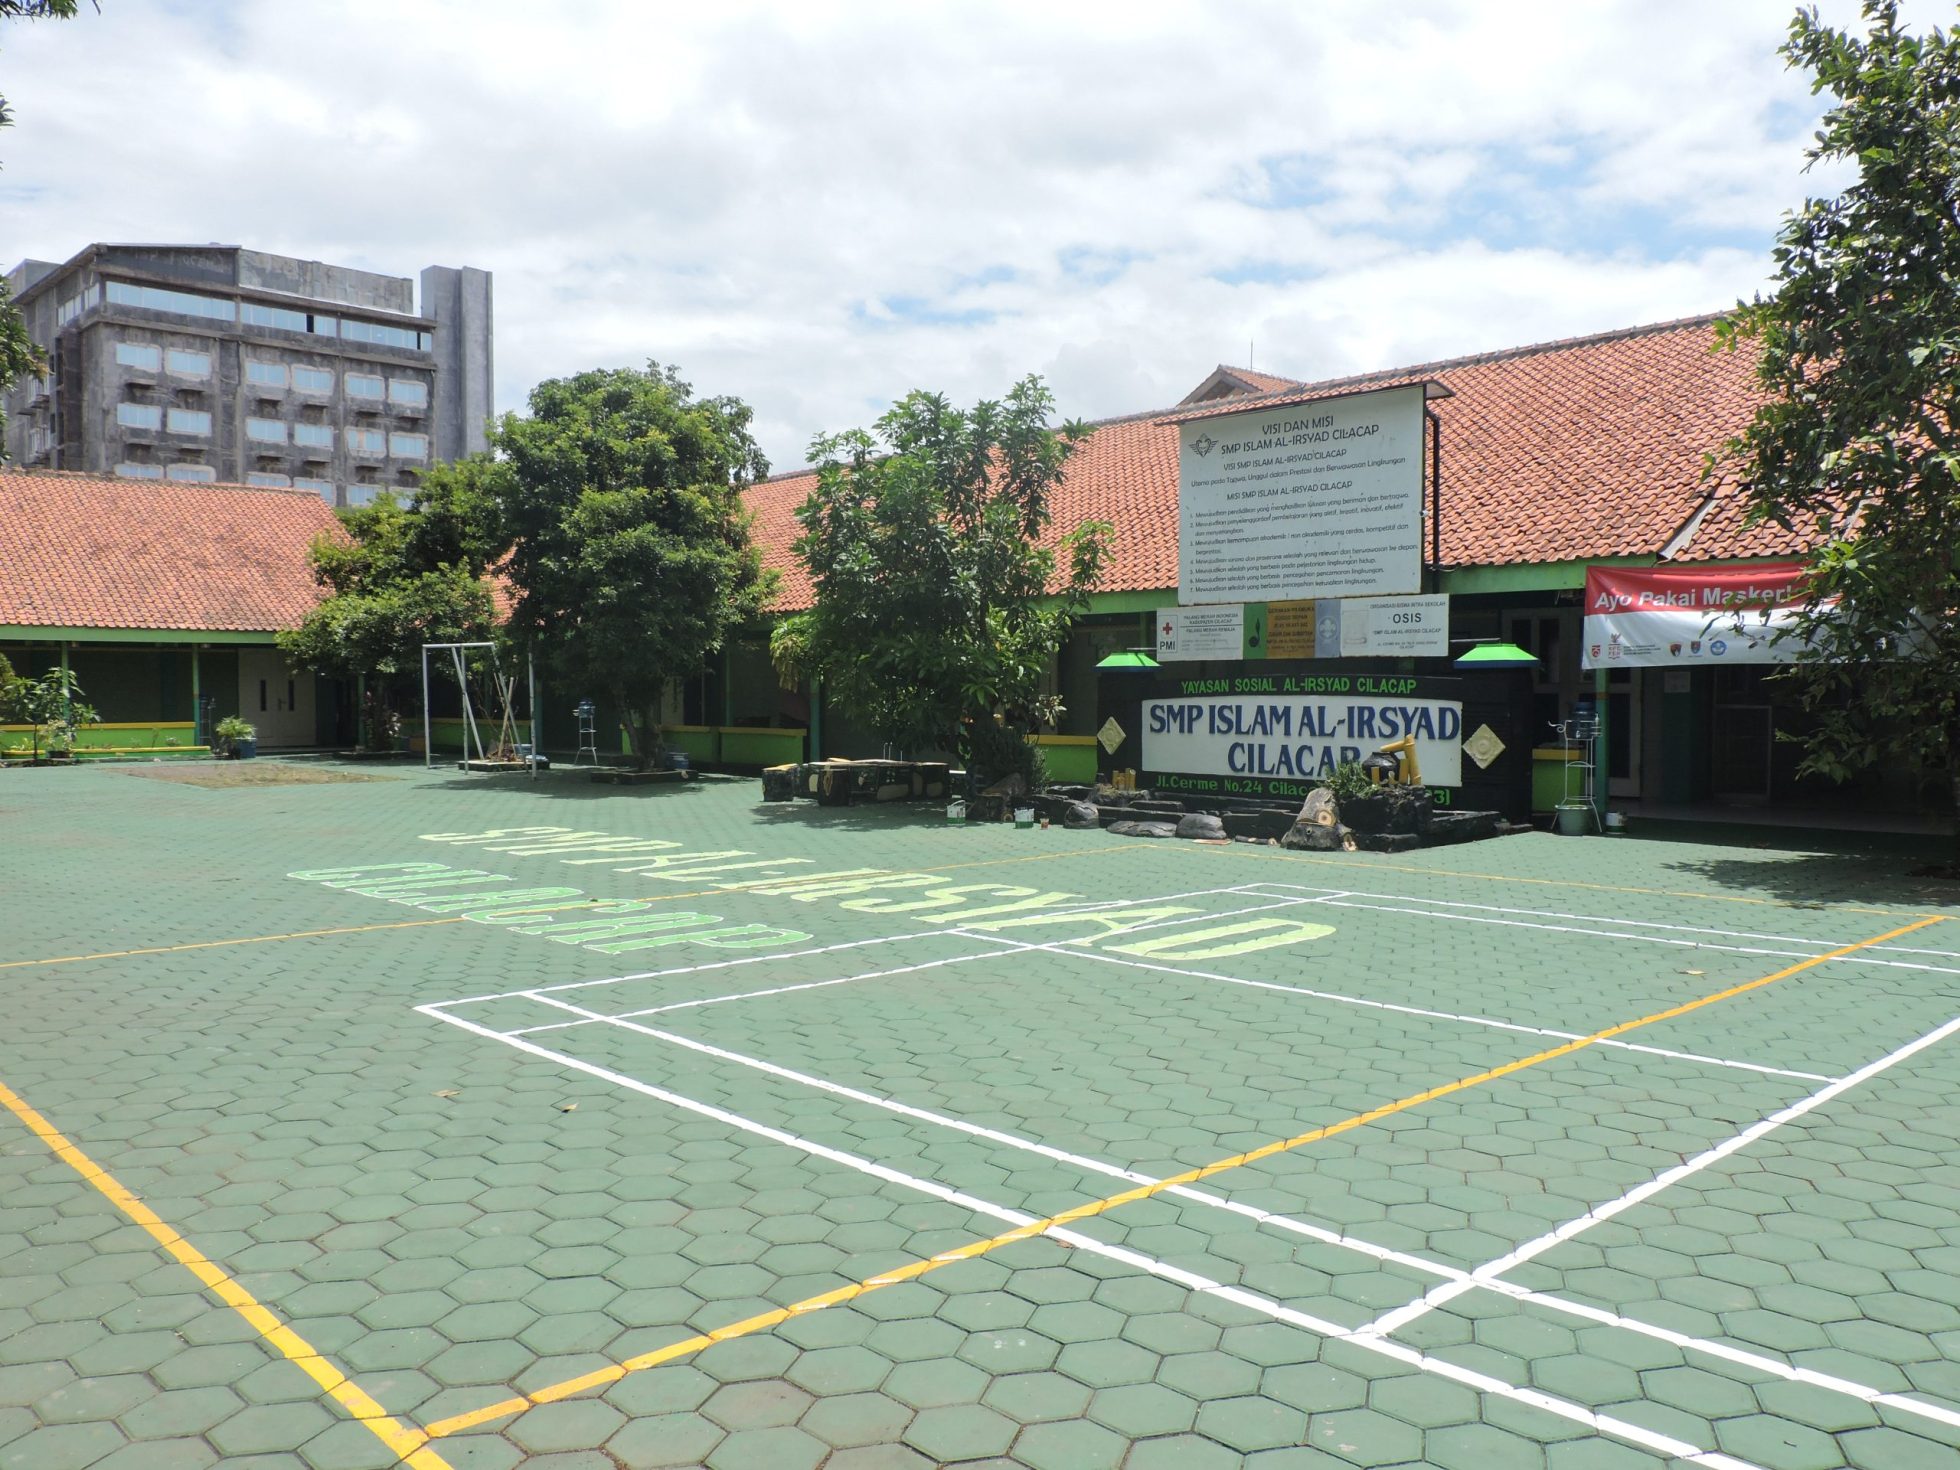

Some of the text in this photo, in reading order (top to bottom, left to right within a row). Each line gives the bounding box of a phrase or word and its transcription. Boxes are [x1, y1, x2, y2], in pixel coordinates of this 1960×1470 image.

[1262, 415, 1333, 435] VISI DAN MISI
[1222, 424, 1379, 454] SMP ISLAM AL-IRSYAD CILACAP
[1253, 458, 1273, 466] ISLAM
[1275, 453, 1312, 464] AL-IRSYAD
[1315, 448, 1346, 459] CILACAP
[1258, 488, 1278, 496] ISLAM
[1280, 484, 1318, 495] AL-IRSYAD
[1320, 480, 1352, 490] CILACAP
[1595, 592, 1632, 612] Ayo
[1637, 588, 1696, 607] Pakai
[1392, 612, 1422, 624] OSIS
[1160, 641, 1176, 651] PMI
[1181, 678, 1417, 694] YAYASAN SOSIAL AL-IRSYAD CILACAP
[1150, 704, 1460, 741] SMP ISLAM AL-IRSYAD
[1224, 779, 1262, 793] No.24
[417, 826, 1337, 961] SMP AL-IRSYAD
[286, 862, 814, 955] CILACAP
